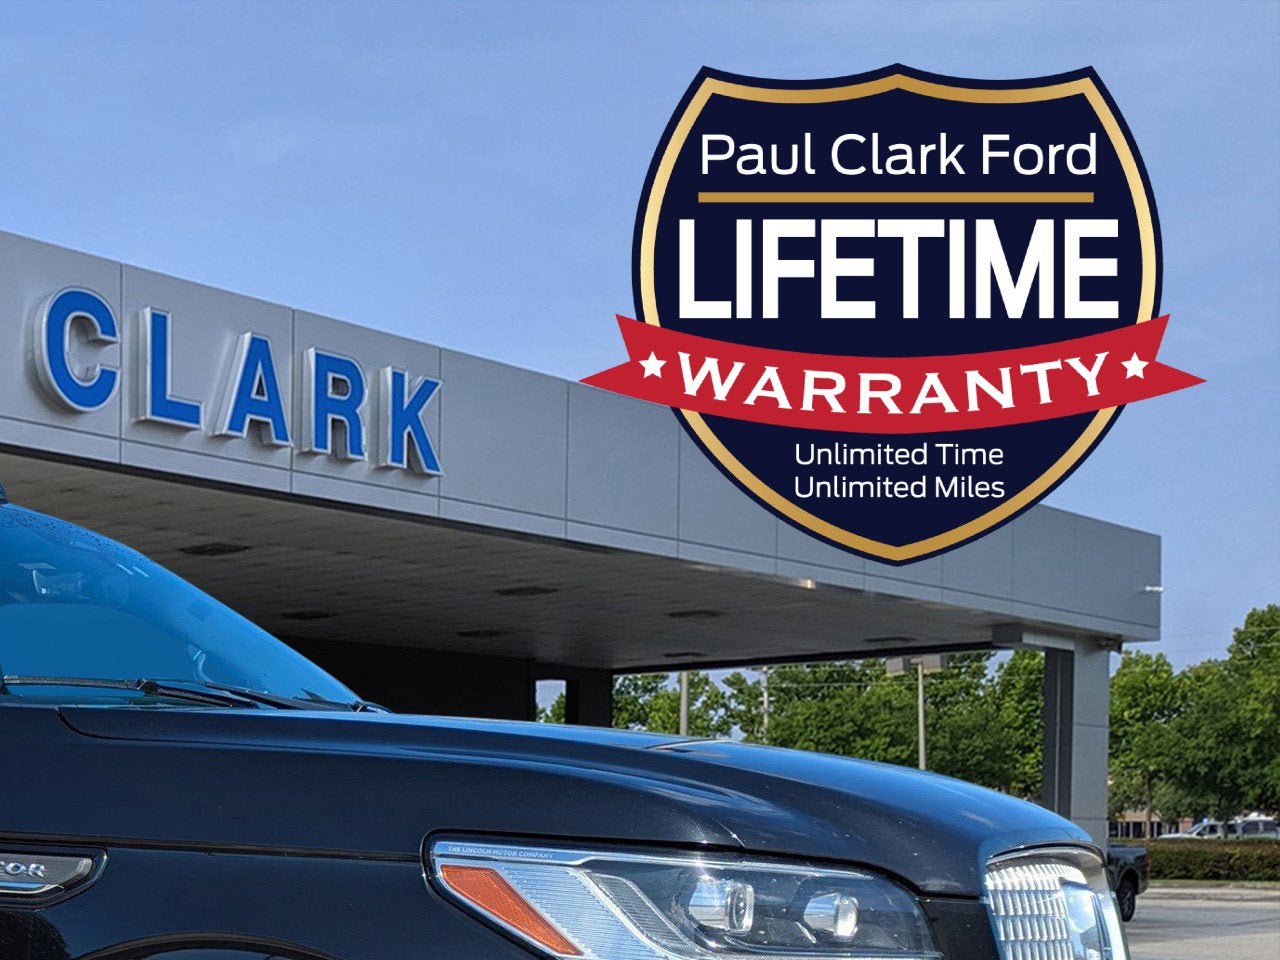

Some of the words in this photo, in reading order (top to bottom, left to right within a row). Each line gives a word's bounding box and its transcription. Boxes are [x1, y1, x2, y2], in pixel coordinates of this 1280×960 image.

[34, 286, 445, 477] CLARK
[492, 848, 518, 857] MOTOR
[518, 850, 554, 859] COMPANY
